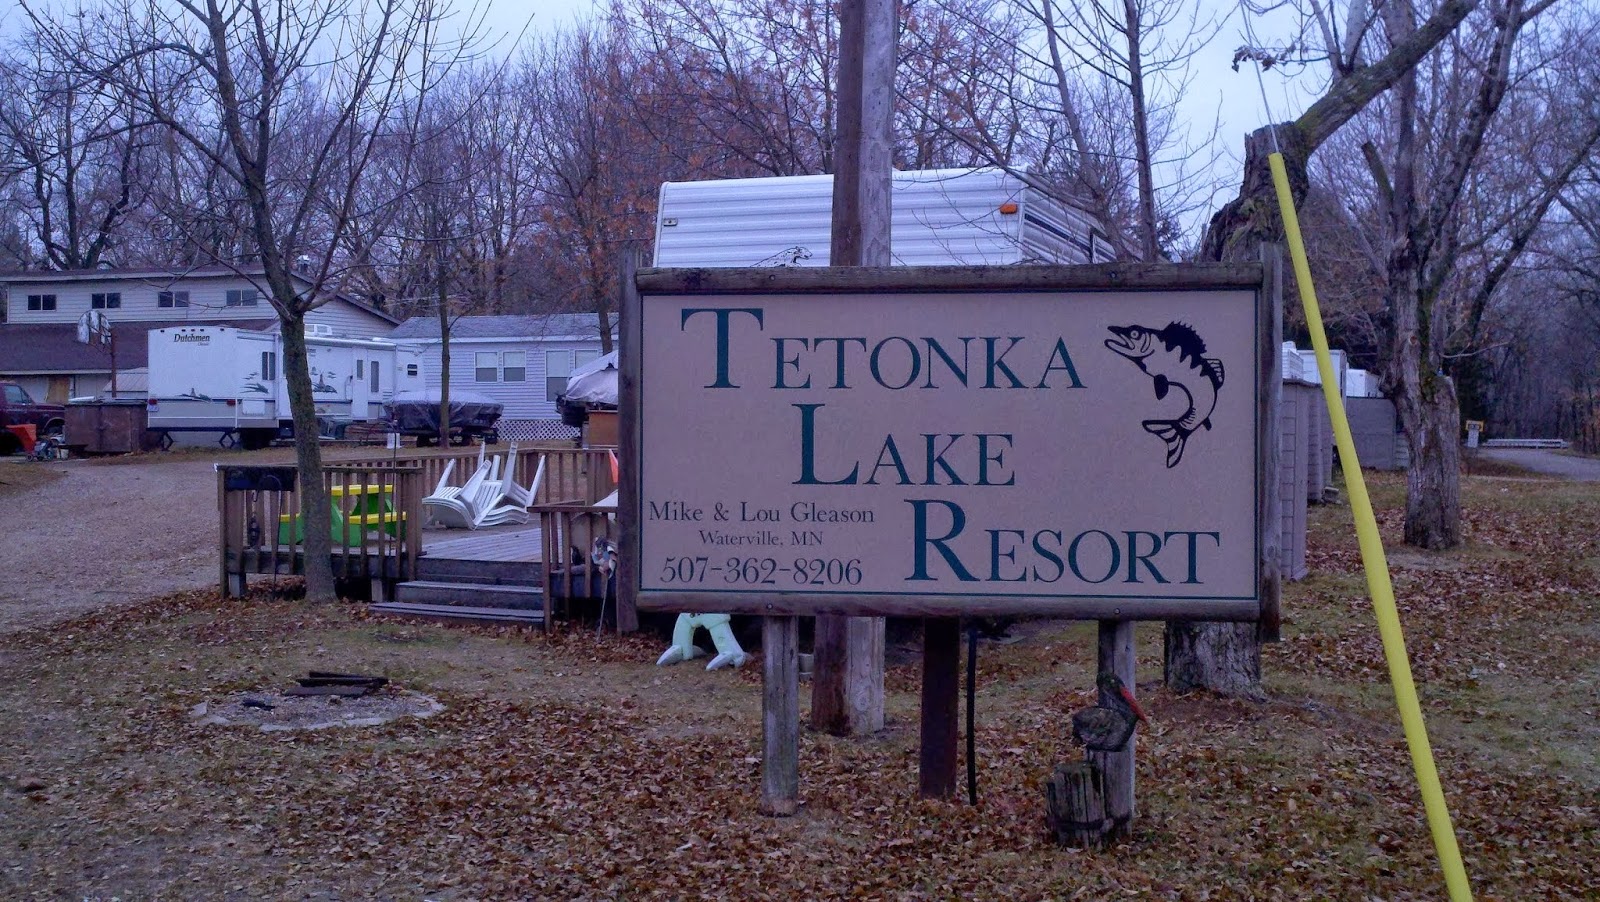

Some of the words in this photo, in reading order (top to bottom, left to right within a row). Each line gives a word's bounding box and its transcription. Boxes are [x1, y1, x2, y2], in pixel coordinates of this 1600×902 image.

[174, 333, 210, 343] Dutchmen
[681, 307, 1089, 391] TETONKA
[791, 403, 1016, 487] LAKE
[649, 501, 703, 522] Mike
[713, 501, 730, 522] &
[740, 501, 781, 523] Lou
[790, 501, 875, 524] Gleason
[791, 530, 824, 546] MN
[904, 498, 1220, 585] RESORT
[659, 556, 863, 586] 507-362-8206
